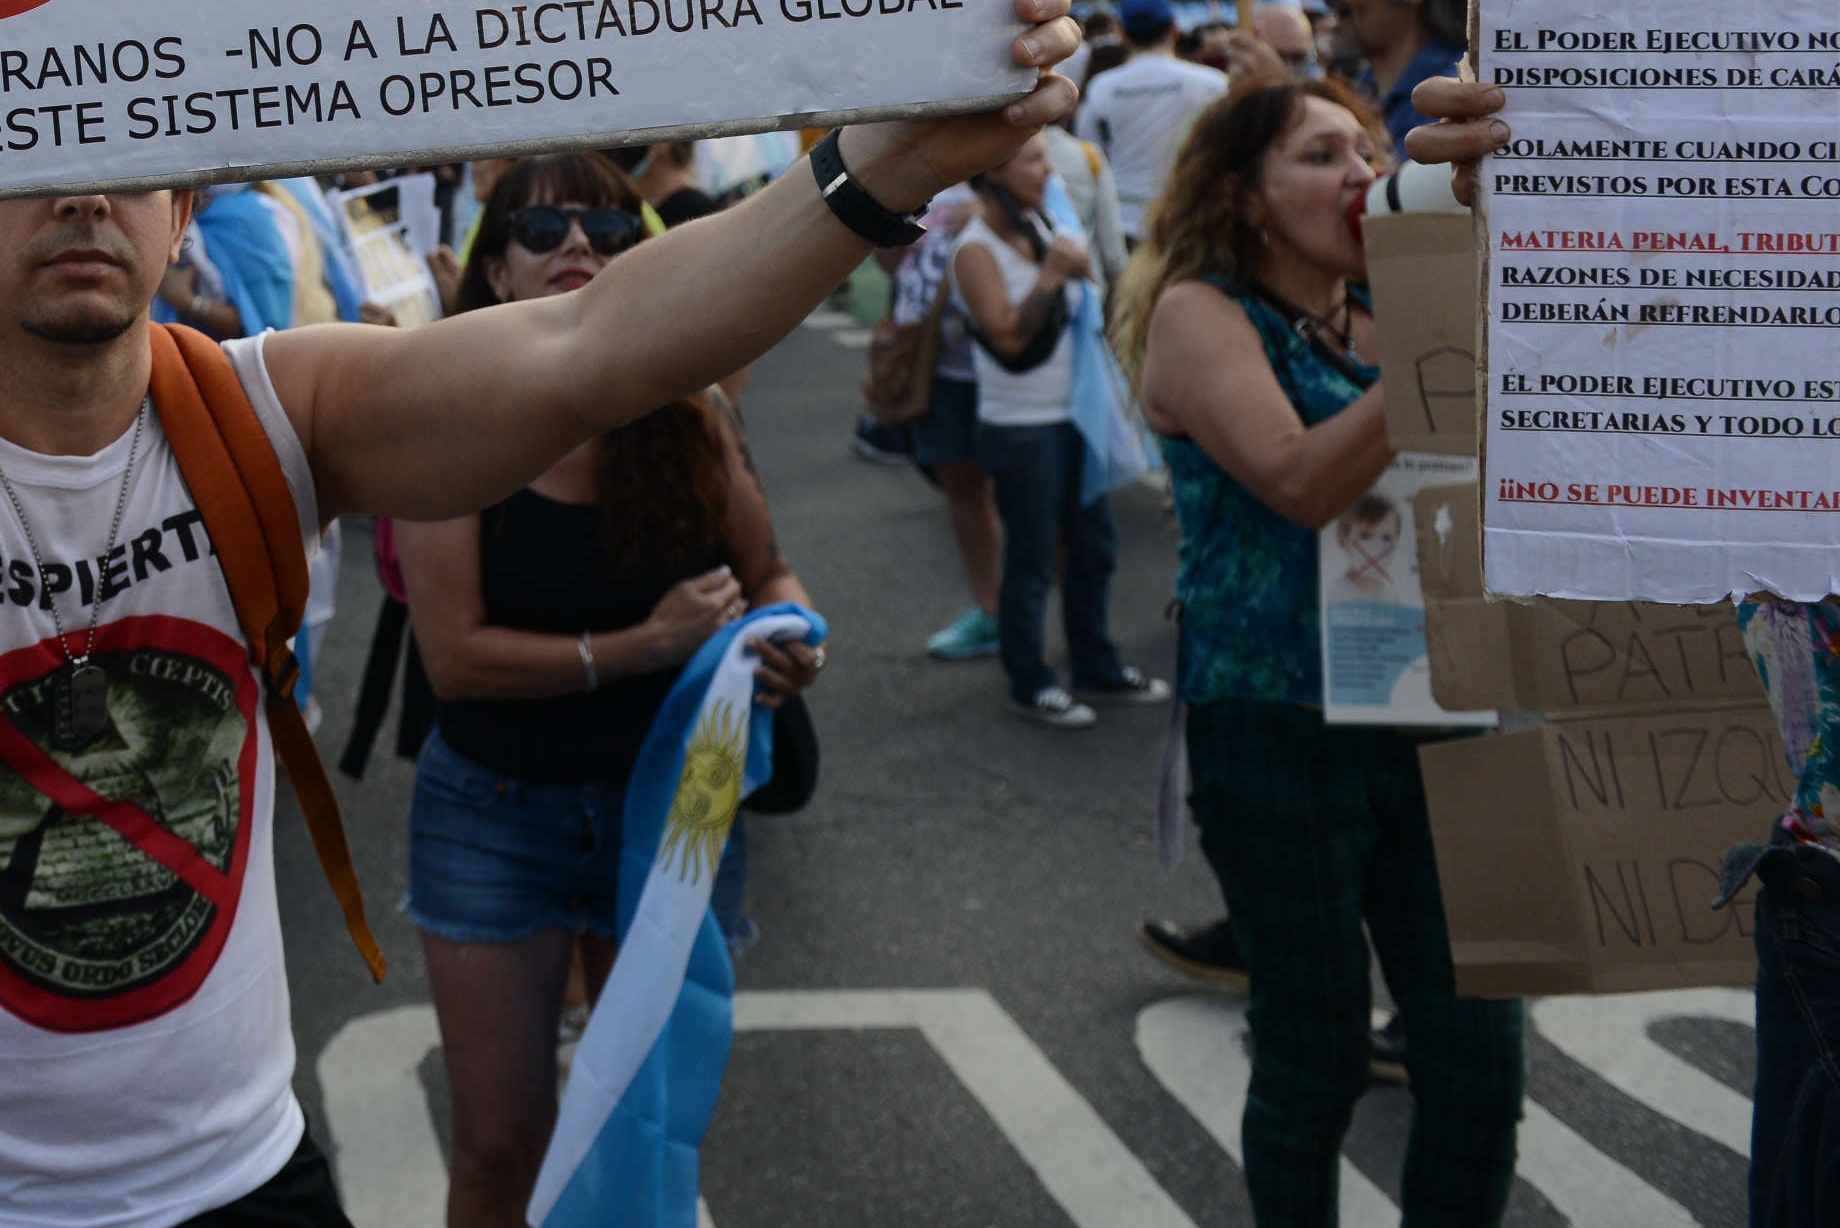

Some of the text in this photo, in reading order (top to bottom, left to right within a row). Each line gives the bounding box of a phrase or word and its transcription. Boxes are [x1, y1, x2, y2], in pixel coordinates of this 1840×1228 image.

[344, 20, 377, 60] A
[397, 14, 457, 55] LA
[1494, 67, 1717, 87] DISPOSICIONES
[1727, 68, 1762, 87] DE
[127, 81, 361, 139] SISTEMA
[380, 58, 619, 115] OPRESOR
[1675, 140, 1801, 159] CUANDO
[1495, 175, 1648, 195] PREVISTOS
[1657, 177, 1717, 195] POR
[1725, 178, 1792, 196] ESTA
[1500, 231, 1624, 250] MATERIA
[1632, 231, 1730, 253] PENAL,
[1501, 267, 1631, 286] RAZONES
[1640, 268, 1677, 286] DE
[1501, 298, 1629, 323] DEBERÁN
[1540, 374, 1634, 394] PODER
[1643, 377, 1796, 399] EJECUTIVO
[1501, 410, 1686, 432] SECRETARIAS
[1693, 415, 1713, 433] Y
[1720, 416, 1804, 435] TODO
[1568, 484, 1599, 502] SE
[1607, 485, 1698, 505] PUEDE
[1558, 730, 1624, 810] NI
[1585, 859, 1656, 946] NI
